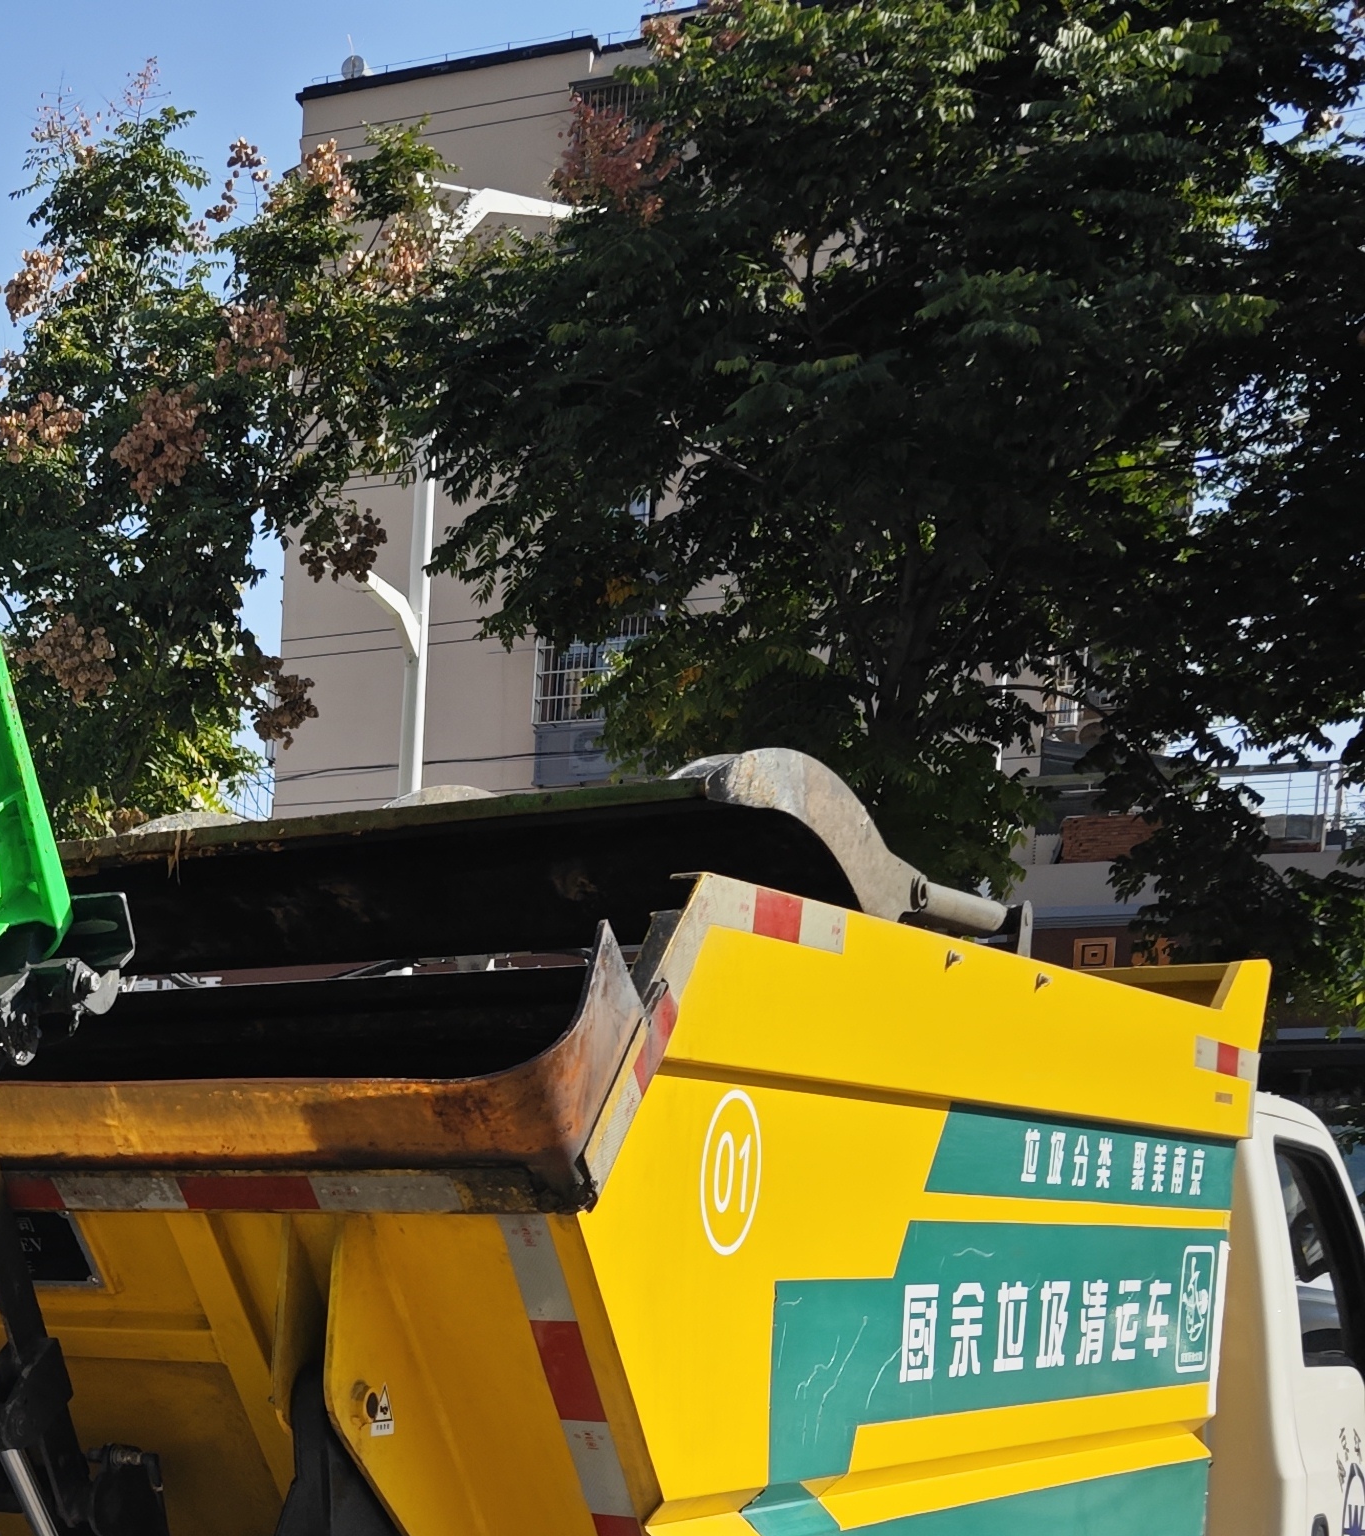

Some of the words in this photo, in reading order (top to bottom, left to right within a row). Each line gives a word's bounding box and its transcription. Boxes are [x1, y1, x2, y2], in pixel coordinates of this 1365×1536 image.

[713, 1130, 751, 1213] 01
[1020, 1127, 1113, 1189] 垃圾分类
[899, 1279, 1172, 1384] 厨余垃圾清运车
